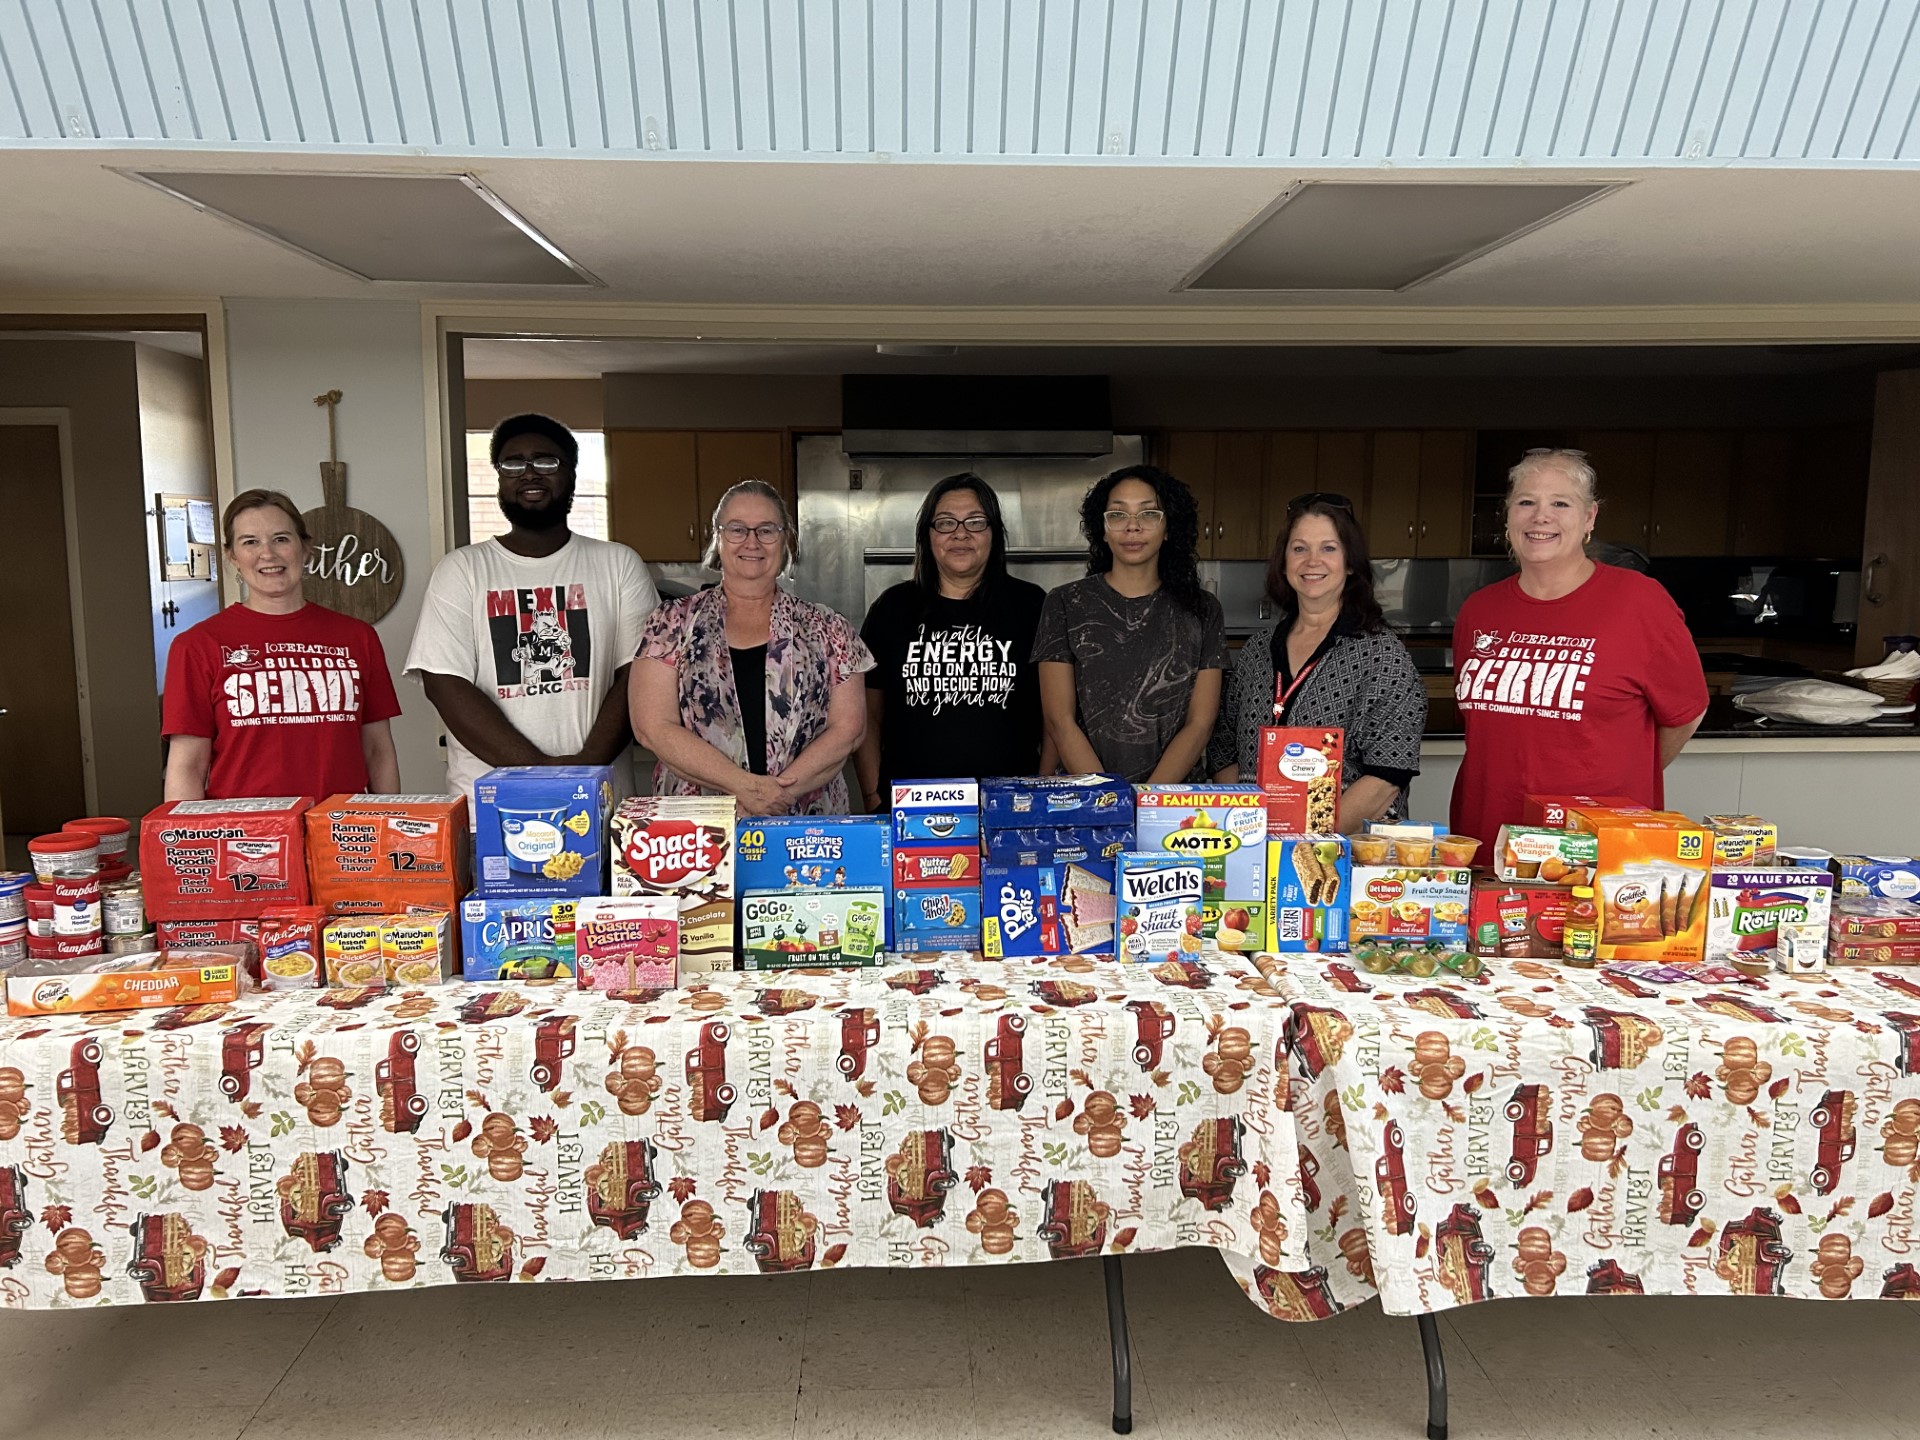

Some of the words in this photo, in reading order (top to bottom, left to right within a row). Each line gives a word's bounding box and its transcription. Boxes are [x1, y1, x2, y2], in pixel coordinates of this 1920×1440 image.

[487, 584, 587, 618] MEXIA
[918, 623, 925, 646] I
[931, 624, 993, 648] match
[539, 645, 551, 657] M
[906, 640, 1012, 663] ENERGY
[1498, 647, 1596, 664] BULLDOGS
[265, 658, 358, 669] BULLDOGS
[902, 662, 918, 678] SO
[923, 662, 941, 676] GO
[946, 662, 964, 676] ON
[969, 661, 1017, 677] AHEAD
[497, 680, 589, 699] BLACKCATS
[906, 677, 930, 692] AND
[933, 677, 978, 692] DECIDE
[982, 676, 1011, 692] HOW
[1455, 658, 1592, 710] SERVE
[224, 670, 360, 717] SERVE
[906, 691, 929, 707] we
[988, 682, 1015, 710] act
[1473, 702, 1487, 711] THE
[1488, 703, 1534, 716] COMMUNITY
[1536, 708, 1560, 719] SINCE
[1561, 711, 1582, 722] 1946
[231, 716, 261, 727] SERVING
[262, 716, 278, 725] THE
[279, 714, 325, 724] COMMUNITY
[326, 713, 345, 722] SINCE
[1267, 732, 1276, 741] 10
[1291, 764, 1316, 774] Chewy
[911, 790, 921, 802] 12
[926, 790, 965, 801] PACKS
[1140, 794, 1158, 802] 40
[1163, 794, 1216, 807] FAMILY
[1220, 794, 1261, 807] PACK
[923, 815, 960, 826] OREO
[1234, 816, 1258, 827] FRUIT
[1546, 809, 1564, 820] 20
[174, 828, 245, 841] Maruchan
[332, 823, 376, 833] Ramen
[1232, 822, 1263, 833] VEGGIE
[332, 832, 377, 843] Noodle
[630, 825, 712, 860] Snack
[740, 830, 765, 846] 40
[785, 837, 805, 848] RICE
[805, 835, 843, 847] KRISPIES
[1170, 836, 1233, 850] MOTT'S
[1681, 835, 1701, 848] 30
[166, 847, 214, 857] Ramen
[339, 843, 372, 855] Soup
[518, 841, 556, 852] Original
[738, 846, 767, 855] Classic
[788, 844, 842, 860] TREATS
[1514, 840, 1555, 851] Mandarin
[335, 855, 377, 865] Chicken
[745, 853, 762, 861] SIZE
[1517, 849, 1552, 858] Oranges
[167, 856, 216, 866] Noodle
[388, 852, 418, 871] 12
[649, 845, 713, 879] pack
[919, 857, 950, 869] Nutter
[175, 866, 211, 877] Soup
[340, 864, 373, 873] Flavor
[920, 865, 951, 876] Butter
[182, 878, 208, 886] Beef
[228, 873, 259, 892] 12
[1126, 870, 1199, 898] Welch's
[1727, 875, 1739, 883] 20
[1743, 875, 1782, 884] VALUE
[1786, 875, 1818, 884] PACK
[178, 886, 213, 894] Flavor
[1411, 887, 1428, 895] Fruit
[1429, 887, 1444, 895] Cup
[1619, 889, 1647, 903] Goldfish
[343, 900, 383, 908] Maruchan
[557, 905, 573, 914] 30
[746, 900, 787, 920] GoGo
[921, 897, 945, 912] Chips
[687, 911, 726, 924] Chocolate
[758, 913, 793, 923] SQUEEZ
[1149, 908, 1179, 922] Fruit
[1738, 908, 1804, 933] ROLL-UPS
[582, 920, 642, 936] Toaster
[1140, 919, 1183, 934] Snacks
[1283, 909, 1291, 938] NUTRI
[1291, 910, 1299, 938] GRAIN
[1848, 923, 1864, 934] RITZ
[179, 931, 215, 940] Ramen
[336, 929, 376, 939] Maruchan
[482, 920, 540, 946] CAPRI
[690, 933, 715, 941] Vanilla
[165, 939, 202, 948] Noodle
[585, 931, 643, 951] Pastries
[339, 953, 367, 961] Chicken
[788, 954, 806, 962] FRUIT
[818, 953, 830, 961] THE
[1844, 947, 1860, 958] RITZ
[203, 969, 211, 981] 9
[211, 967, 229, 975] LUNCH
[211, 973, 229, 981] PACKS
[123, 976, 180, 991] CHEDDAR
[120, 1047, 153, 1131] HARVEST
[950, 1072, 992, 1142] Gather
[344, 1094, 388, 1165] Gather
[1463, 1094, 1495, 1178] HARVEST
[22, 1105, 69, 1179] Gather
[1010, 1105, 1051, 1195] Thankful
[857, 1119, 886, 1203] HARVEST
[1425, 1123, 1465, 1195] Gather
[1724, 1128, 1767, 1197] Gather
[554, 1131, 584, 1215] HARVEST
[94, 1137, 139, 1231] Thankful
[1108, 1143, 1153, 1229] Thankful
[514, 1168, 558, 1259] Thankful
[1622, 1165, 1653, 1249] HARVEST
